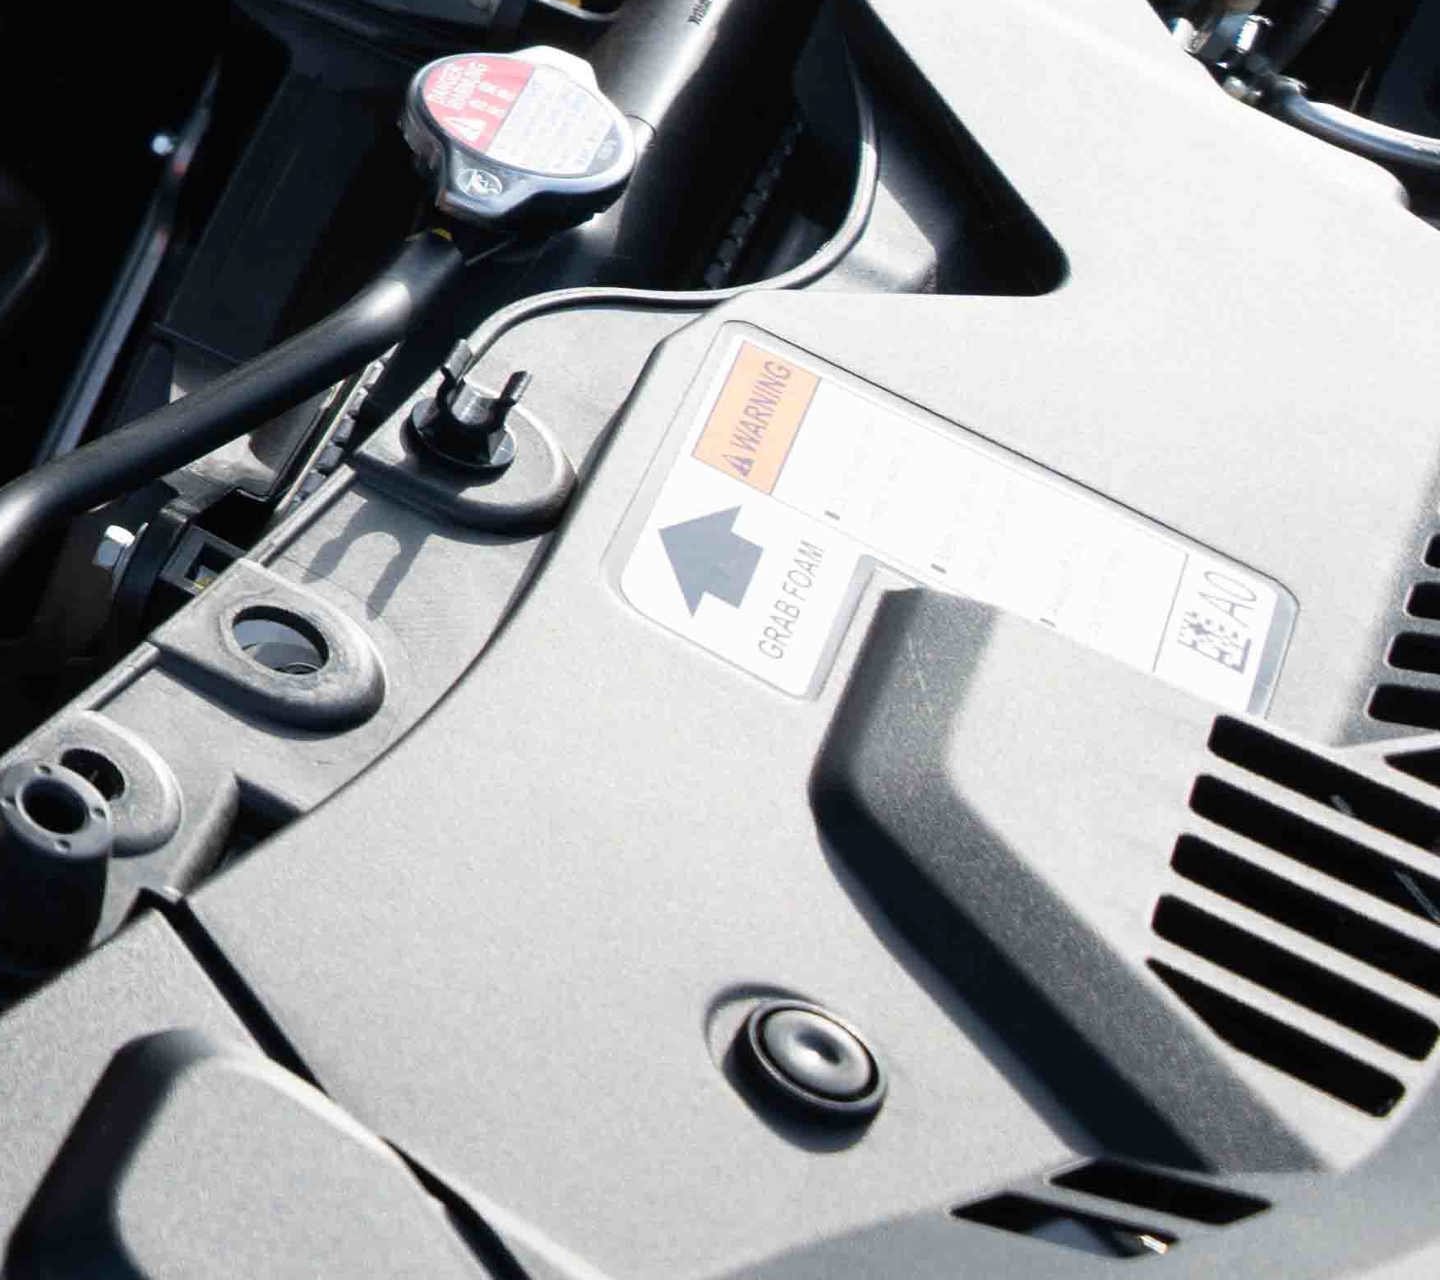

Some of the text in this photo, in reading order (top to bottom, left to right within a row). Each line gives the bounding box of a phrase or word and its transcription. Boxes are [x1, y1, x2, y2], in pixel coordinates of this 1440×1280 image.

[733, 359, 792, 453] WARNING
[758, 539, 826, 660] GRAB FOAM
